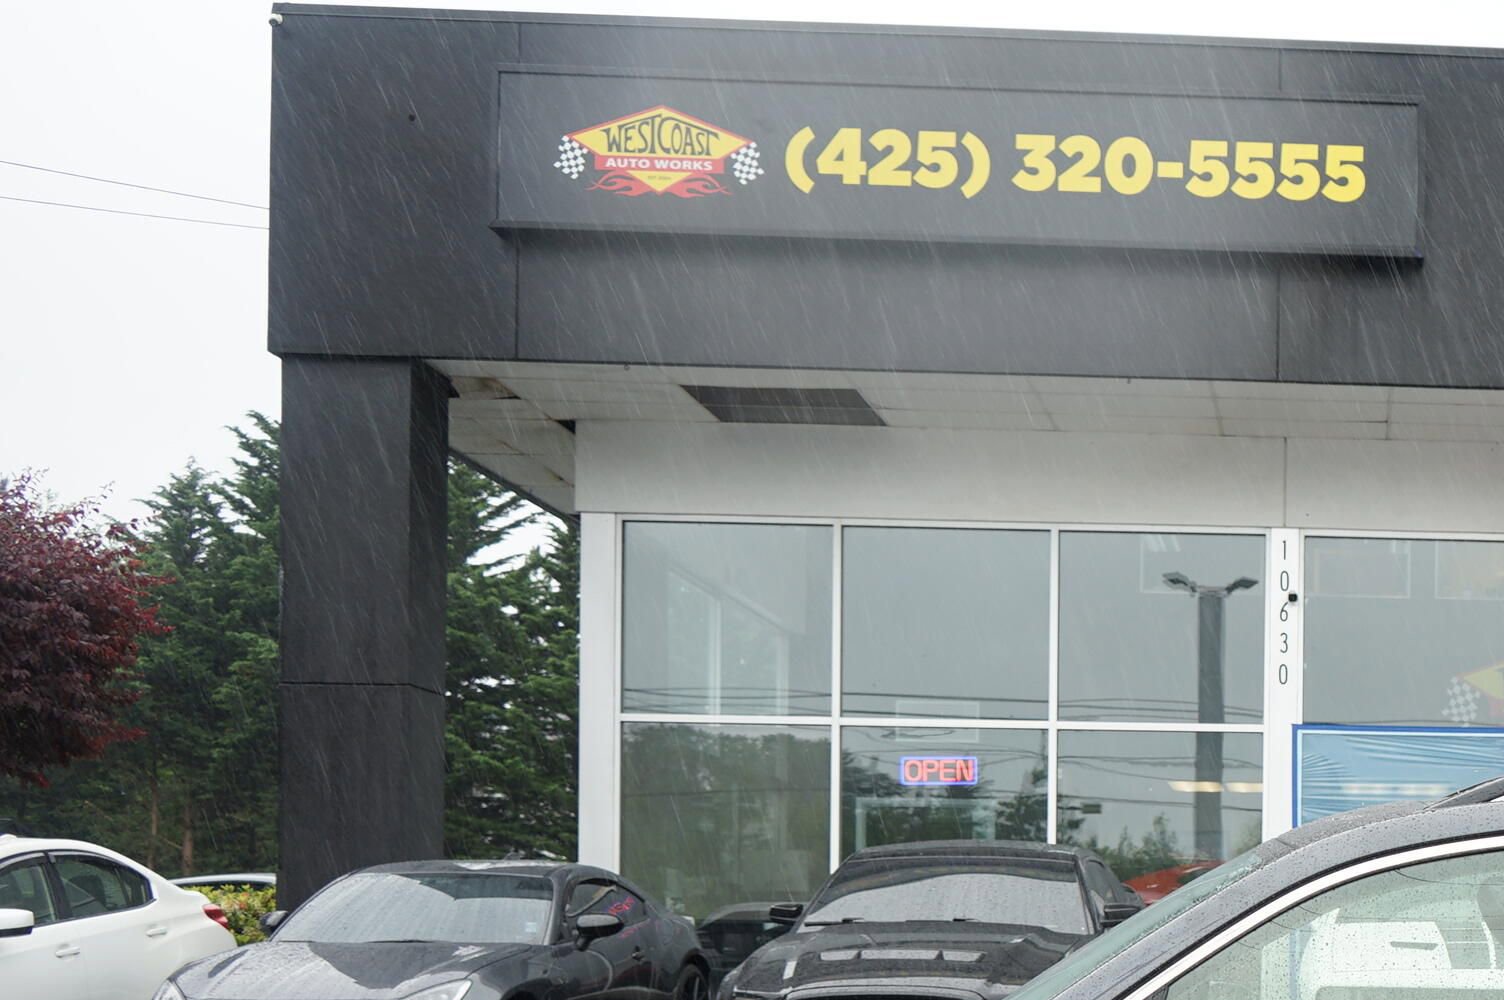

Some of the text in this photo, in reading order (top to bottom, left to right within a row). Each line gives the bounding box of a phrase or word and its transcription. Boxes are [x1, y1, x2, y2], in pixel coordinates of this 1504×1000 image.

[605, 157, 713, 171] AUTO WORKS
[785, 126, 1366, 203] (425) 320-5555
[1278, 540, 1290, 685] 10630
[903, 759, 975, 783] OPEN
